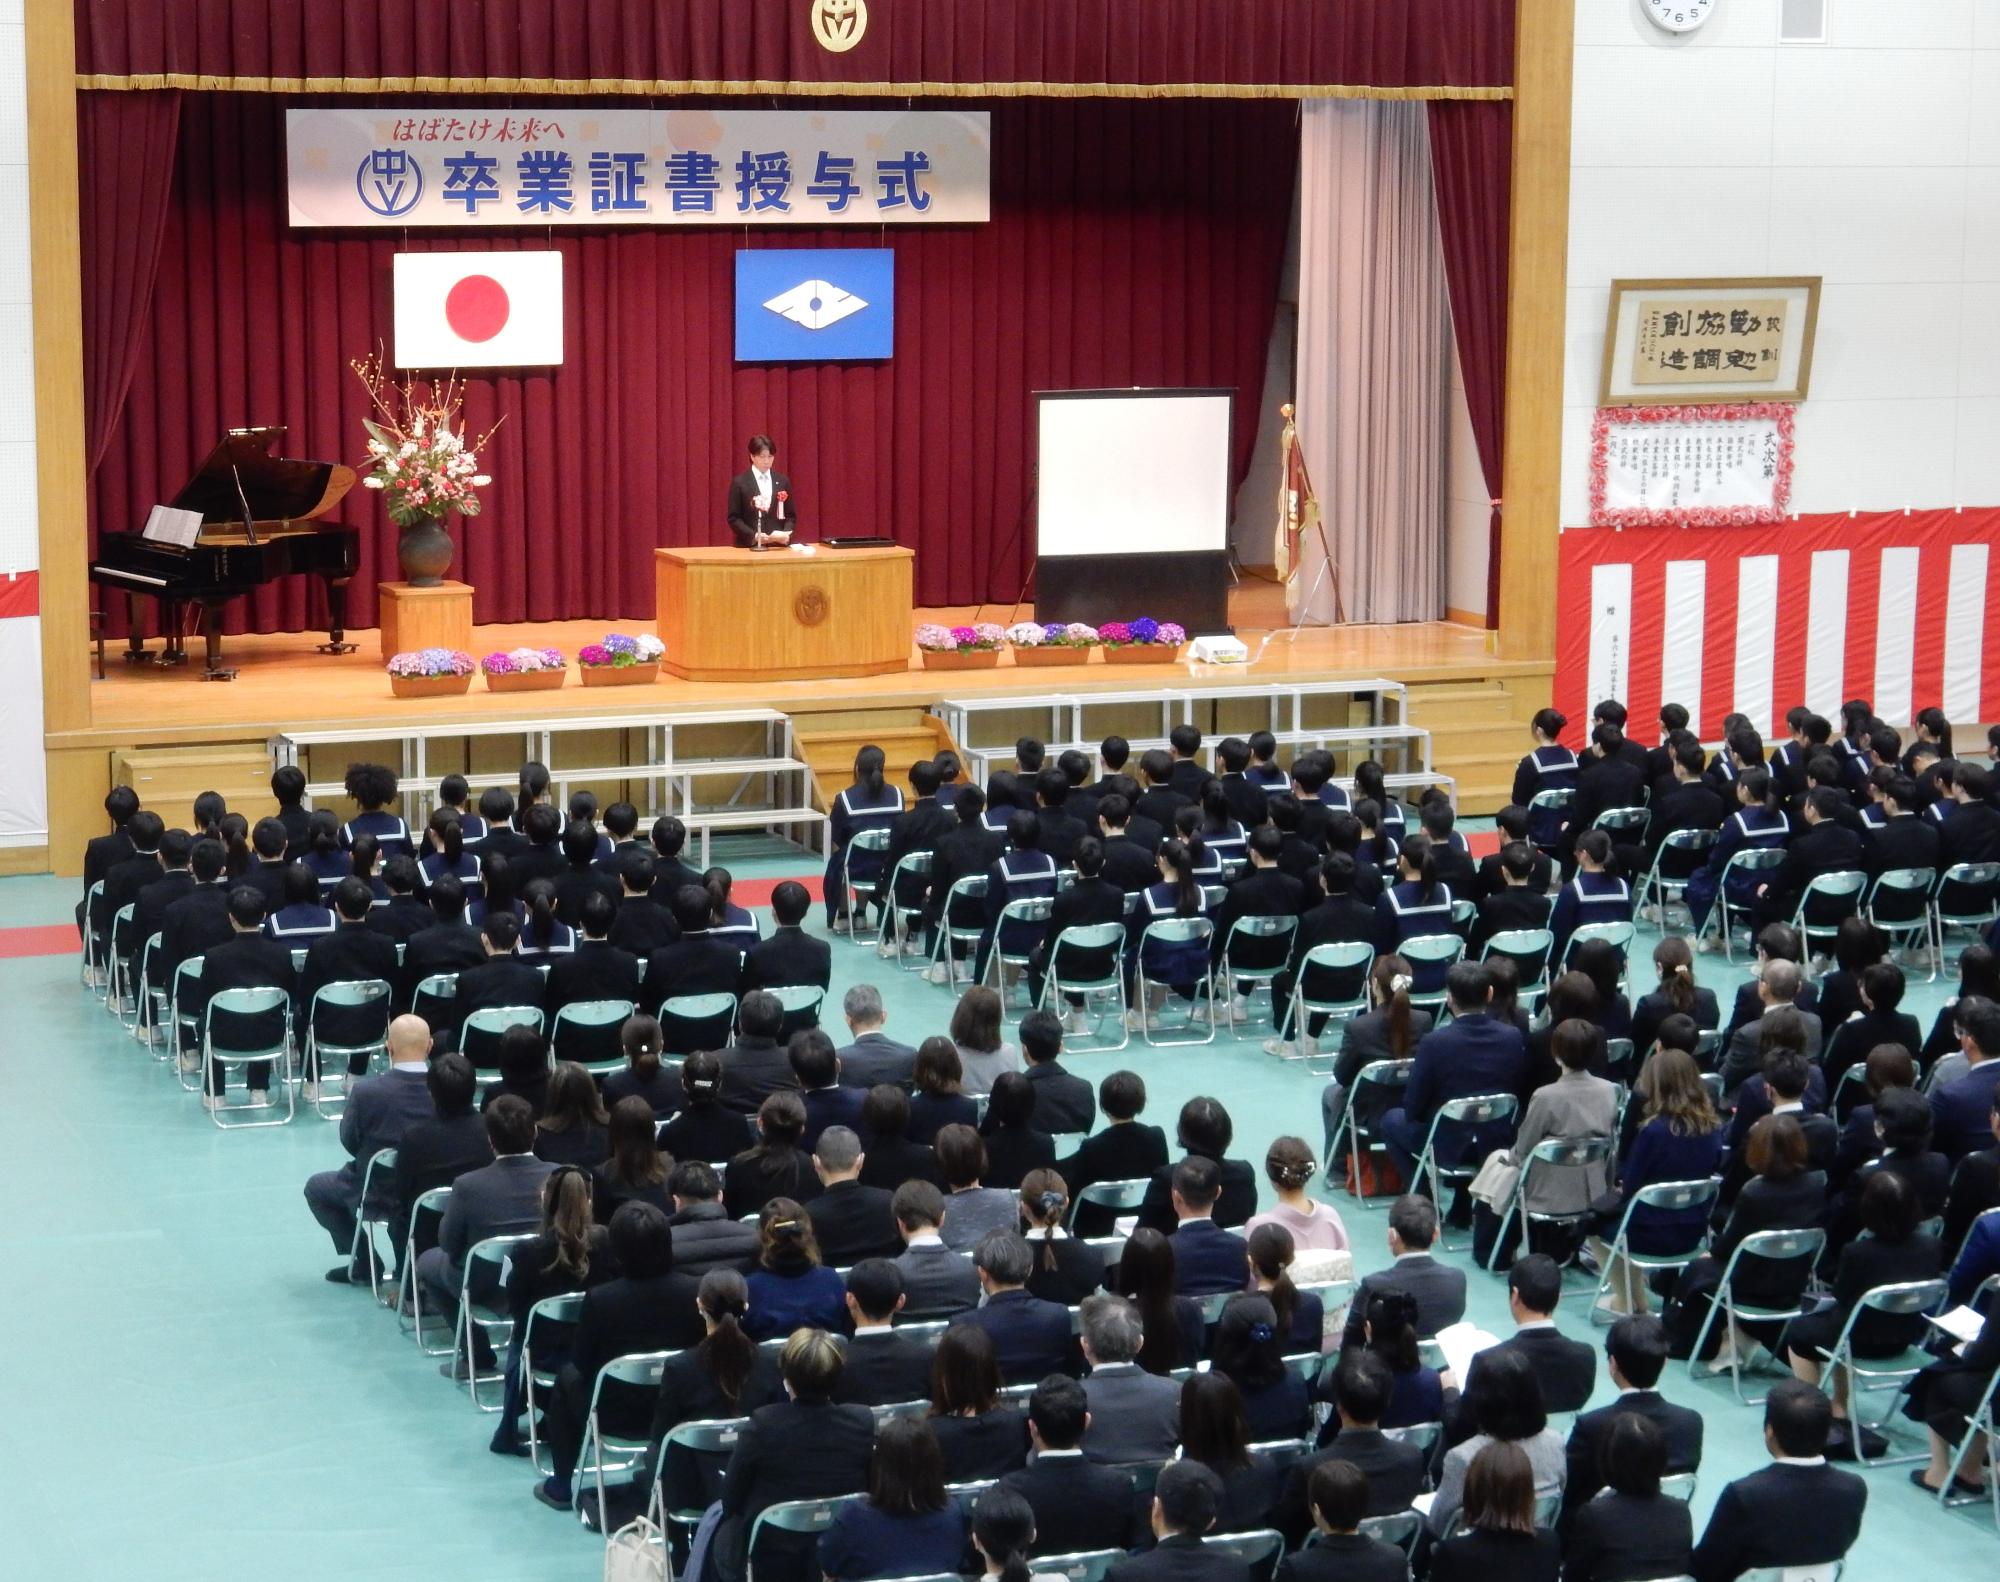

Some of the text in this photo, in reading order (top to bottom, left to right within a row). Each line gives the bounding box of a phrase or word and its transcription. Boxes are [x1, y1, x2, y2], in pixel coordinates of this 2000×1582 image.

[1663, 8, 1671, 17] 7
[1675, 13, 1684, 22] 6
[1690, 8, 1699, 18] 5
[392, 117, 565, 143] はばたけ未来へ
[442, 150, 931, 214] 卒業証書授与式
[1660, 309, 1693, 371] 創造
[1762, 431, 1777, 479] 式次第
